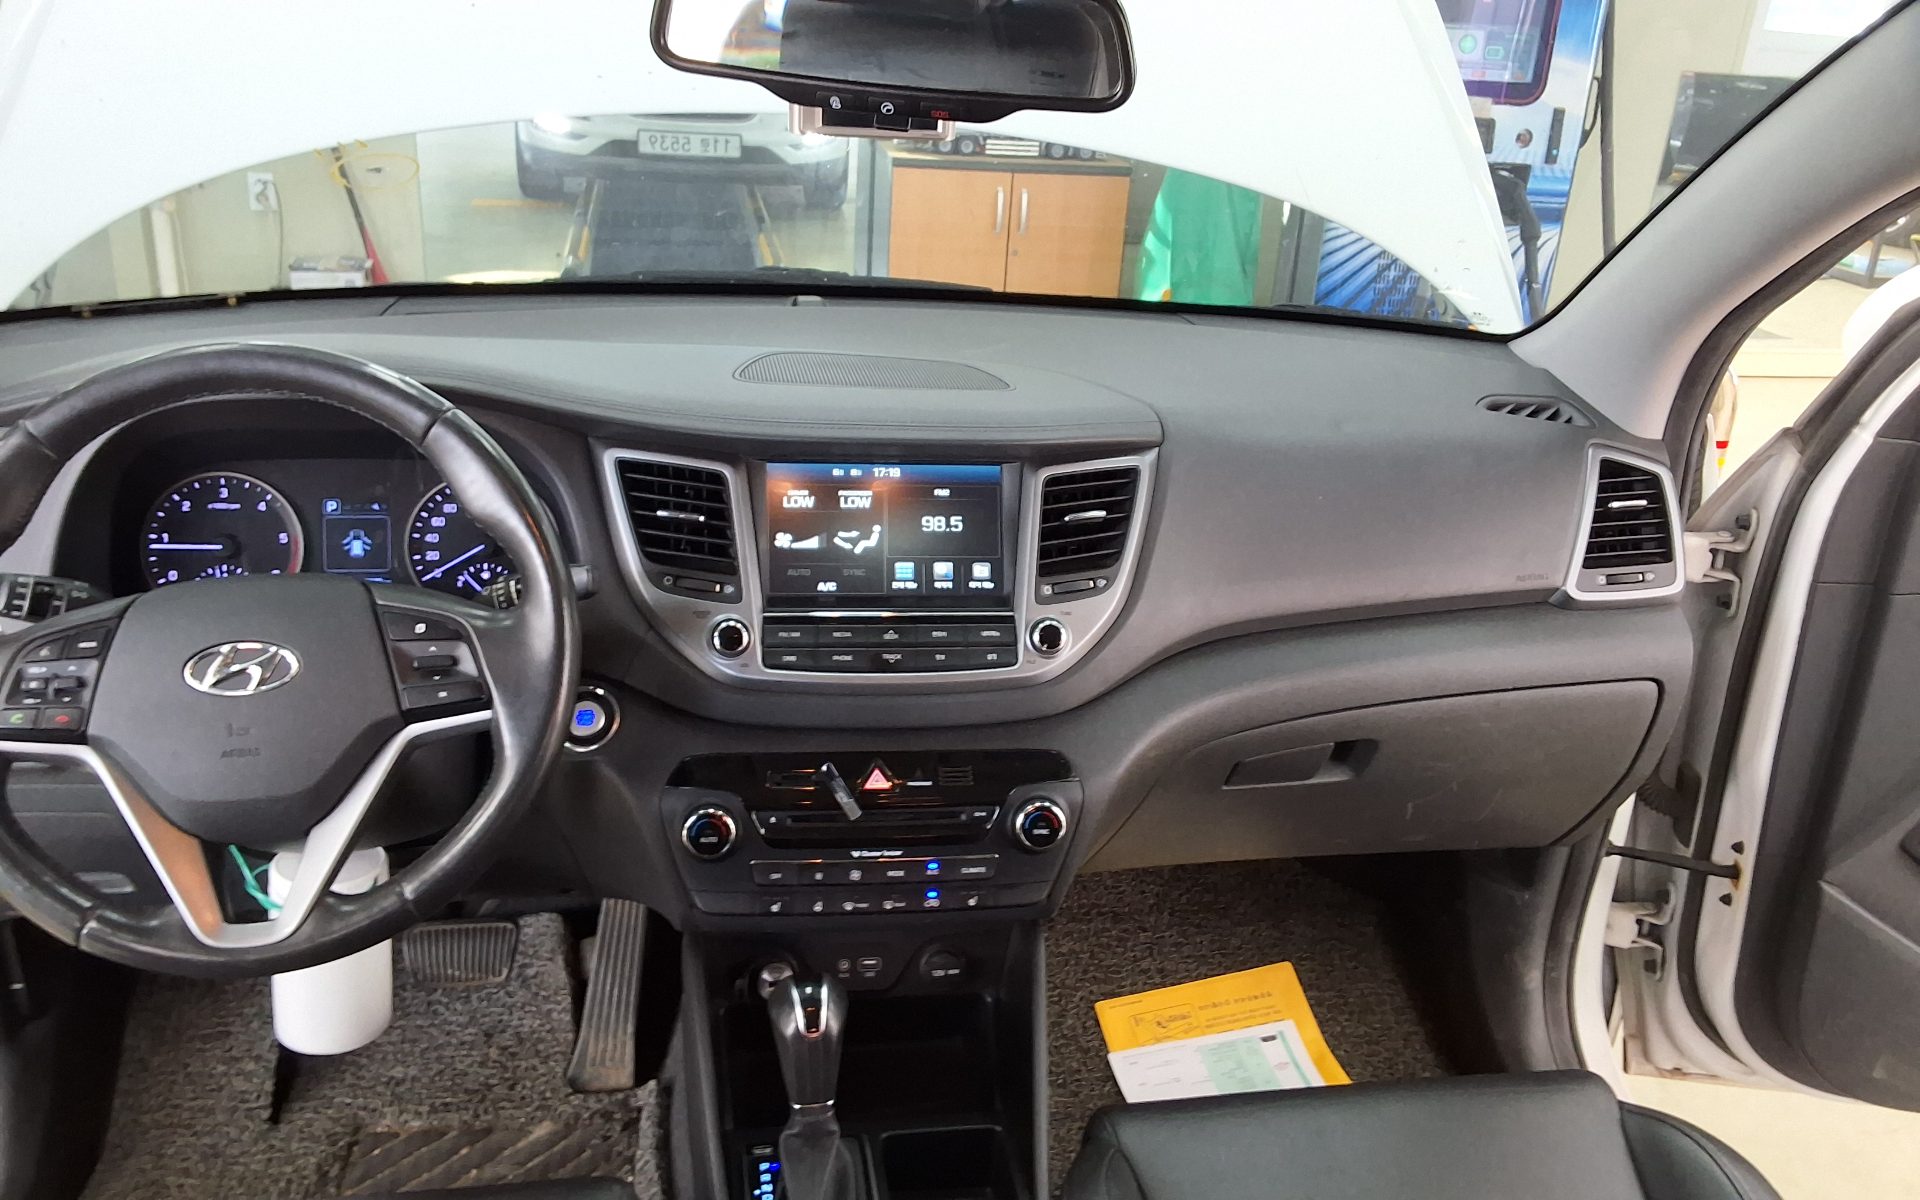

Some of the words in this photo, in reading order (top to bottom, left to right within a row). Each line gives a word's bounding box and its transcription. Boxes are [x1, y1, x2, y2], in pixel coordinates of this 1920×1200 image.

[872, 467, 901, 478] 17:19
[181, 501, 191, 512] 2
[257, 501, 267, 512] 4
[326, 500, 338, 513] P
[783, 496, 815, 508] LOW
[839, 496, 872, 508] LOW
[921, 516, 963, 532] 98.5
[787, 568, 811, 577] AUTO
[843, 568, 866, 577] SYNC
[817, 582, 837, 592] A/C
